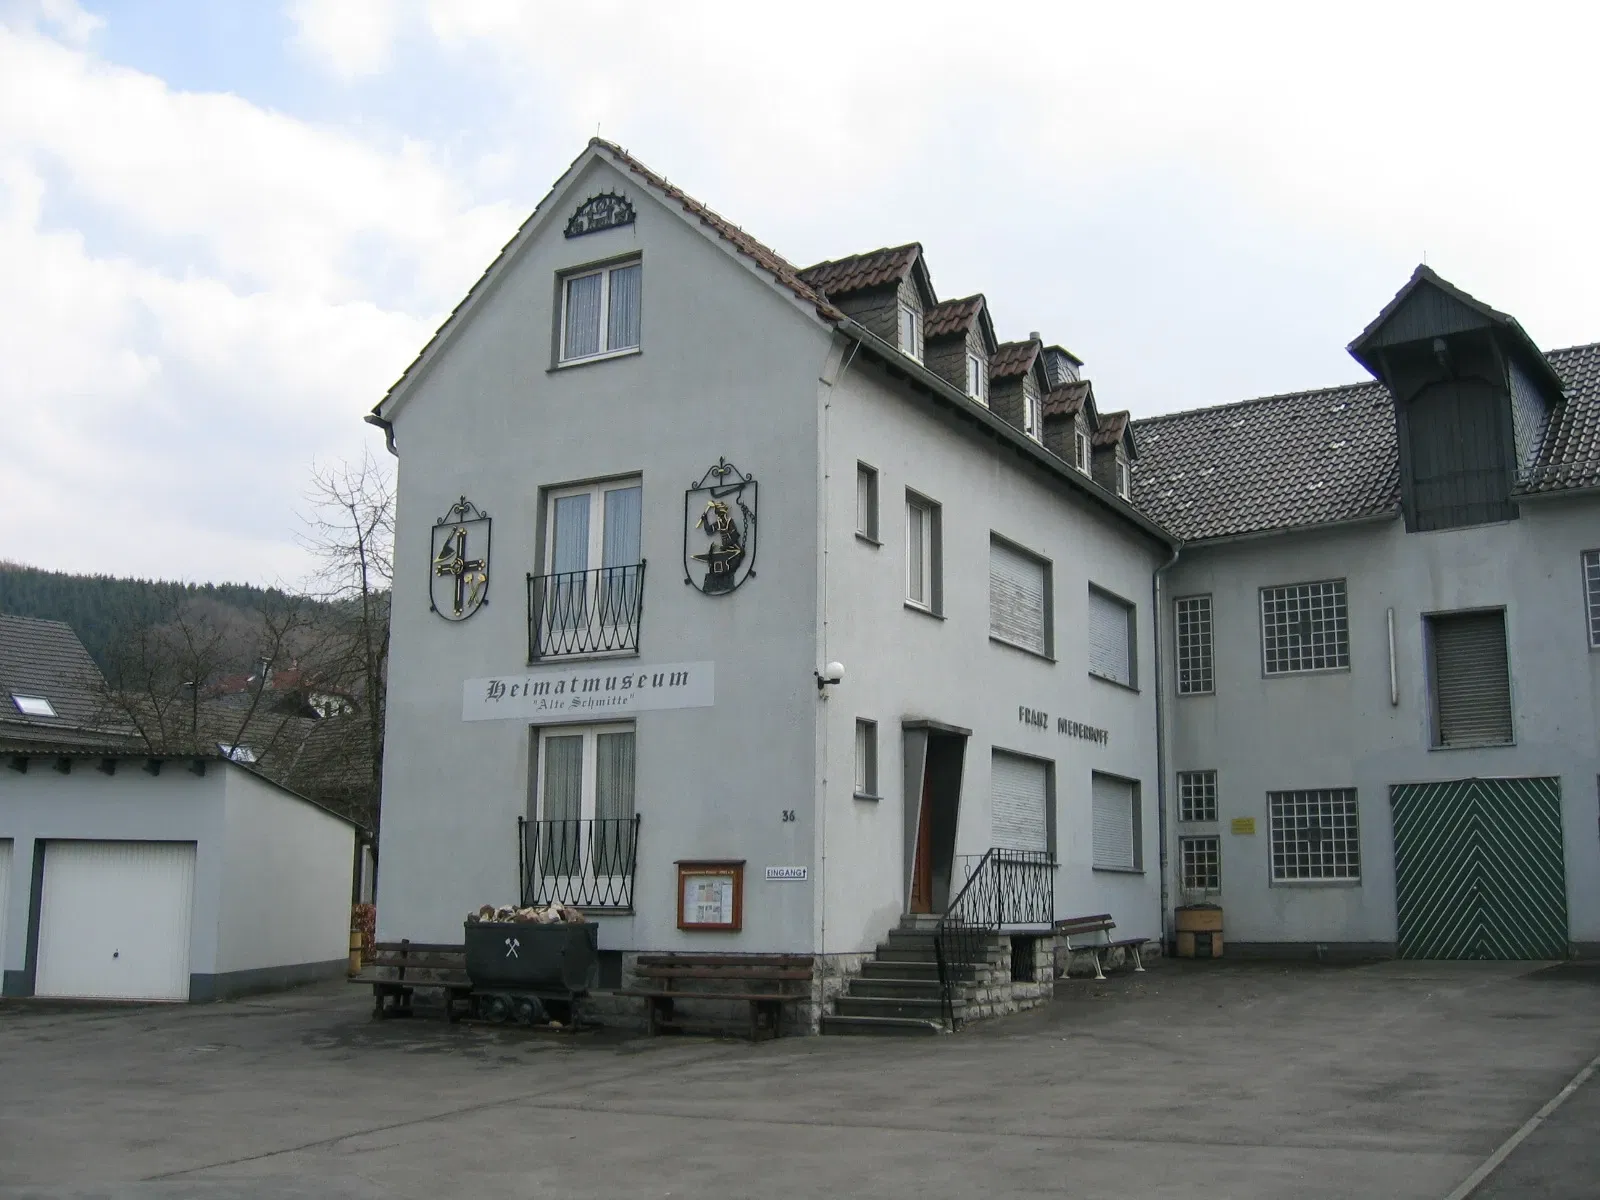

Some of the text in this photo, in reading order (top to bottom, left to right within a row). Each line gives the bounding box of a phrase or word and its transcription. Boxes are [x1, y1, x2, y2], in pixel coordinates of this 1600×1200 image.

[485, 671, 689, 702] Heimatmuseum
[1018, 705, 1048, 730] FRANZ
[782, 810, 795, 822] 36
[767, 868, 802, 877] EINGANG
